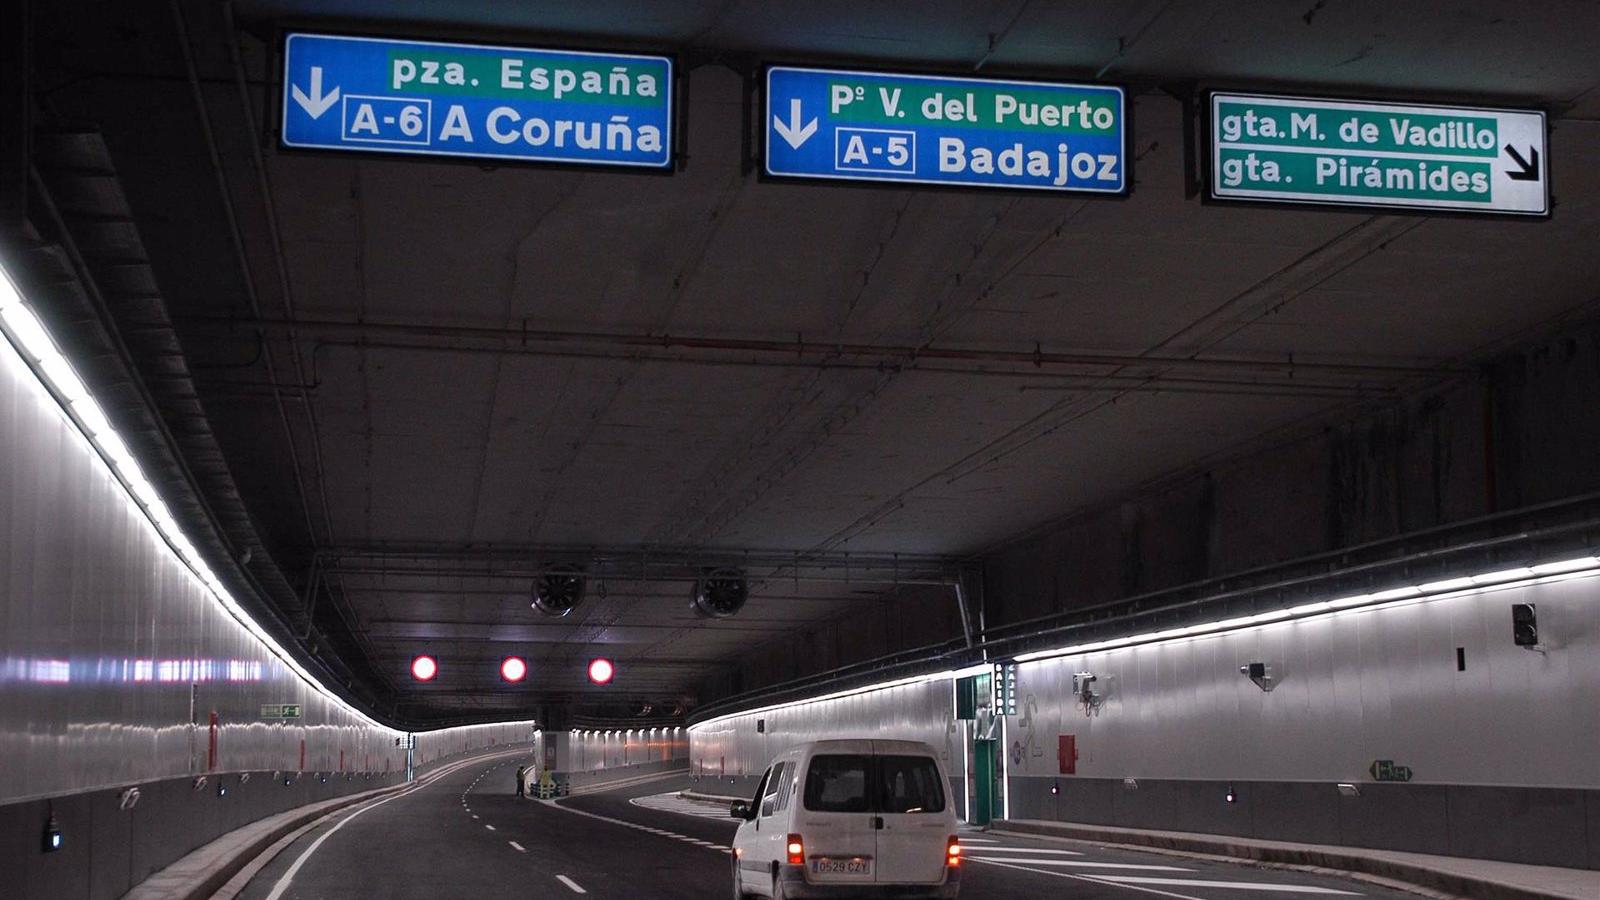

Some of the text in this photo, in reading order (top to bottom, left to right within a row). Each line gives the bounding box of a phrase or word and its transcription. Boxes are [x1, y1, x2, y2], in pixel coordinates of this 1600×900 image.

[392, 58, 658, 99] pza. España
[351, 103, 662, 153] A-6 A Coruña
[879, 87, 905, 118] V.
[921, 92, 977, 122] del
[995, 94, 1114, 129] Puerto
[1339, 116, 1379, 143] de
[1389, 118, 1496, 150] Vadillo
[843, 135, 1119, 186] A-5 Badajoz
[1222, 152, 1489, 193] gta. Pirámides
[995, 664, 1004, 715] SALIDA
[819, 860, 867, 873] 0529 CZY
